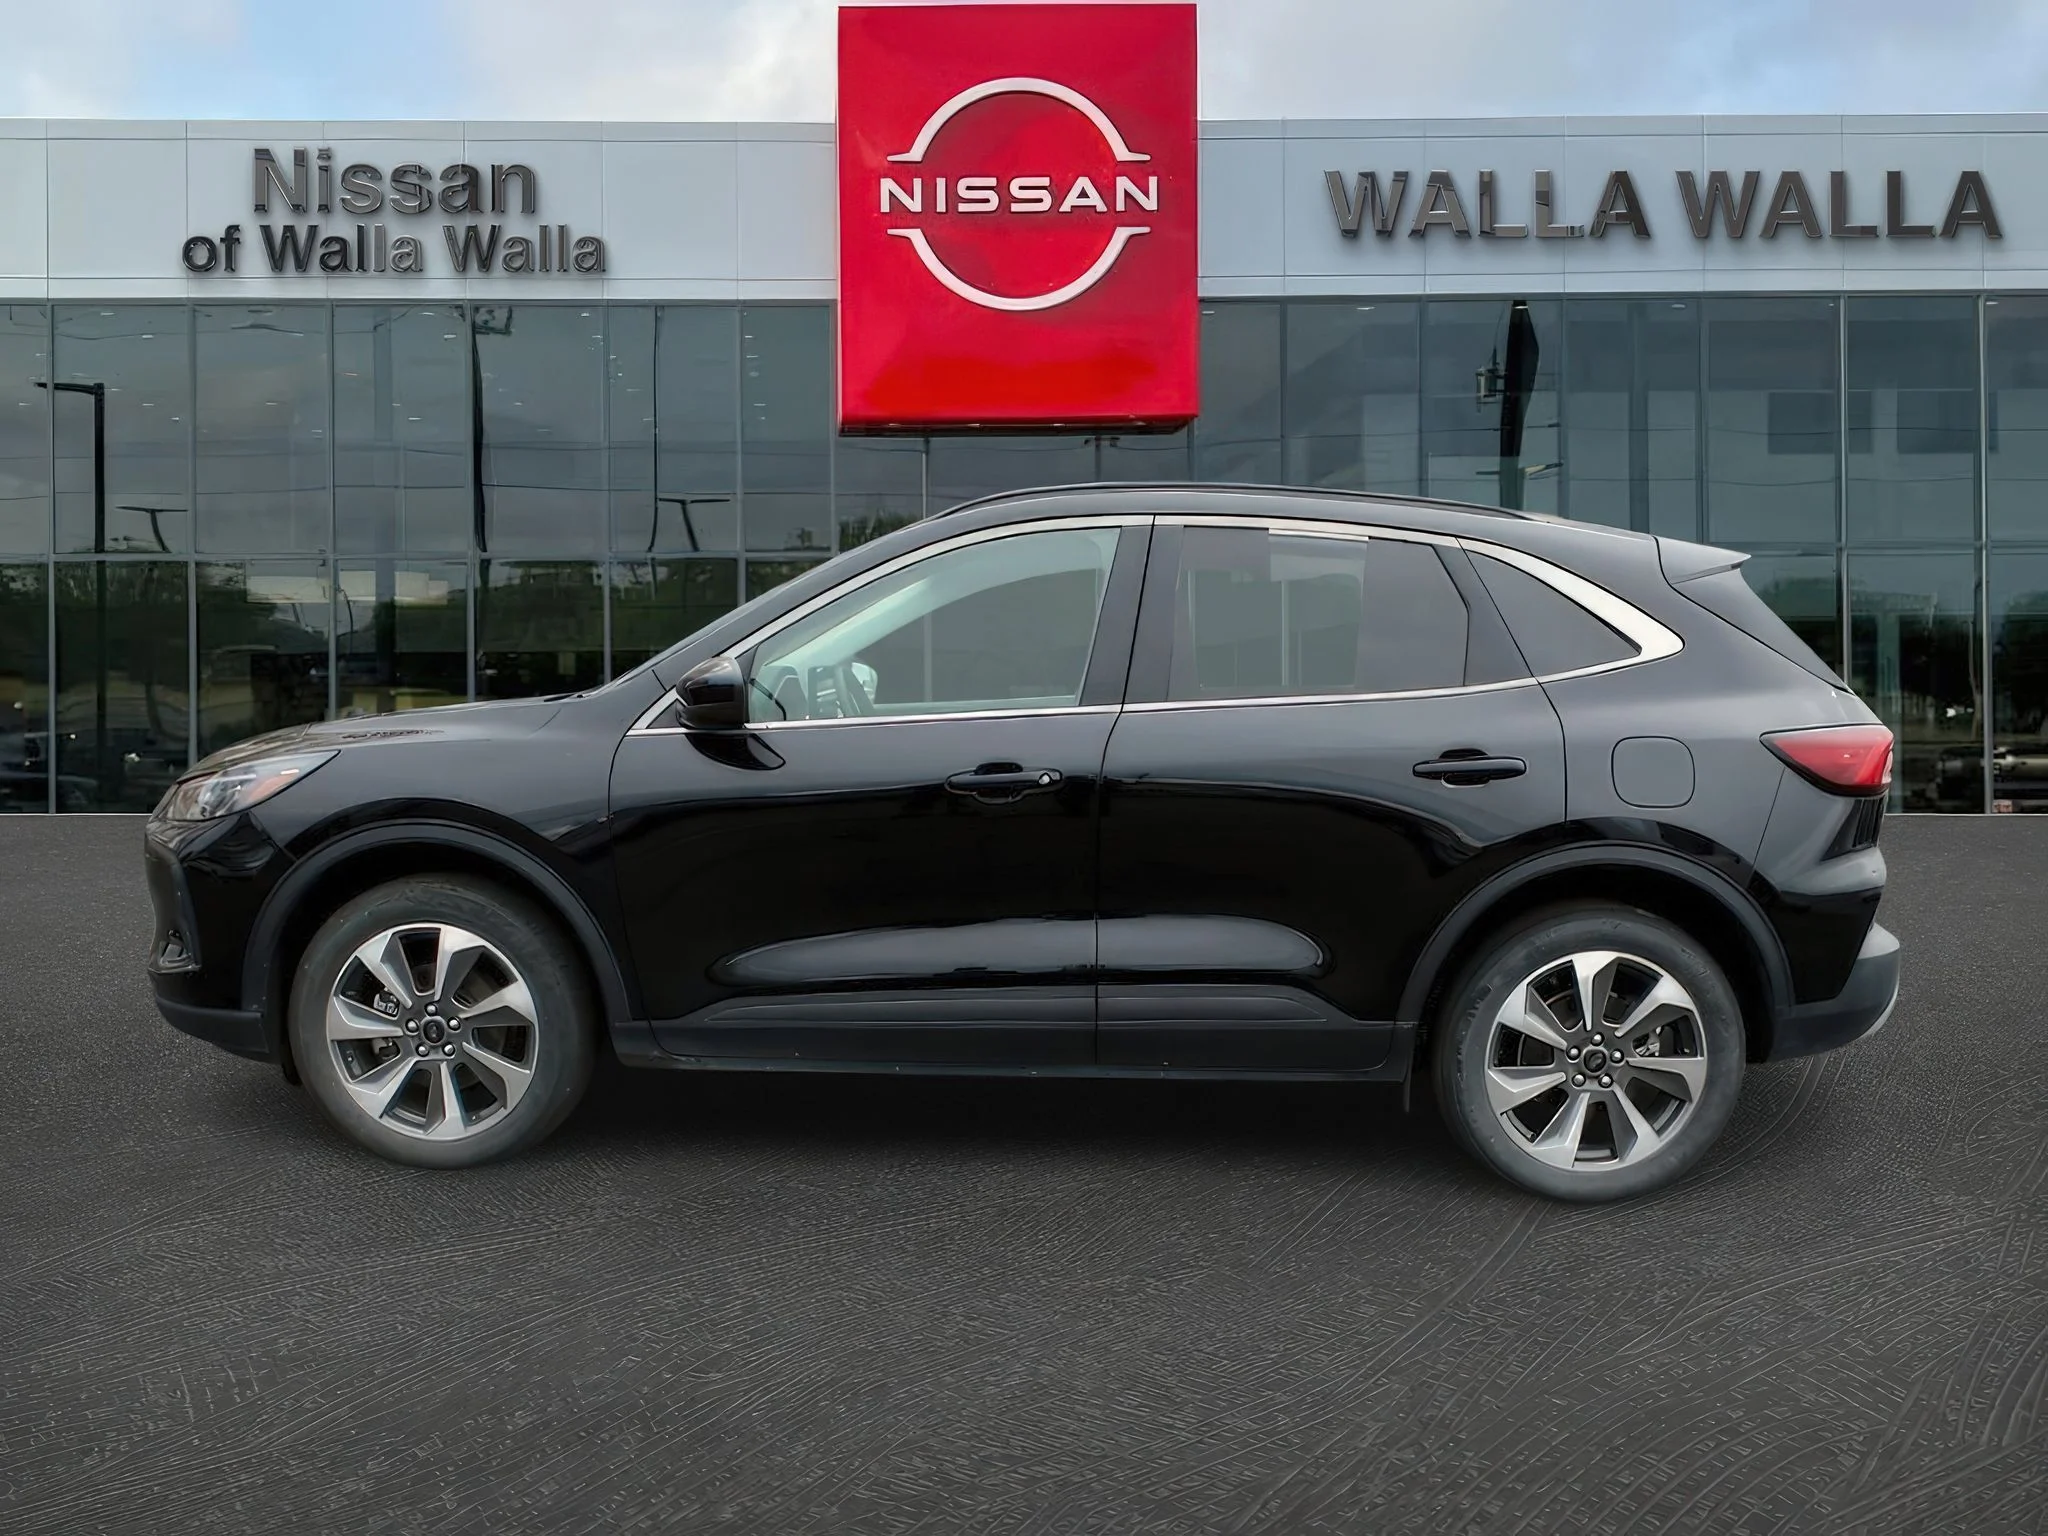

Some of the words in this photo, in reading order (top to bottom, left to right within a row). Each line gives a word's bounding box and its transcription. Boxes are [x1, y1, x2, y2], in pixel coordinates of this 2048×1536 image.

[253, 147, 536, 214] Nissan
[880, 176, 1158, 213] NISSAN
[1323, 168, 1652, 239] WALLA
[1674, 169, 2003, 239] WALLA
[182, 224, 242, 273] of
[259, 223, 424, 273] Walla
[443, 223, 606, 273] Walla
